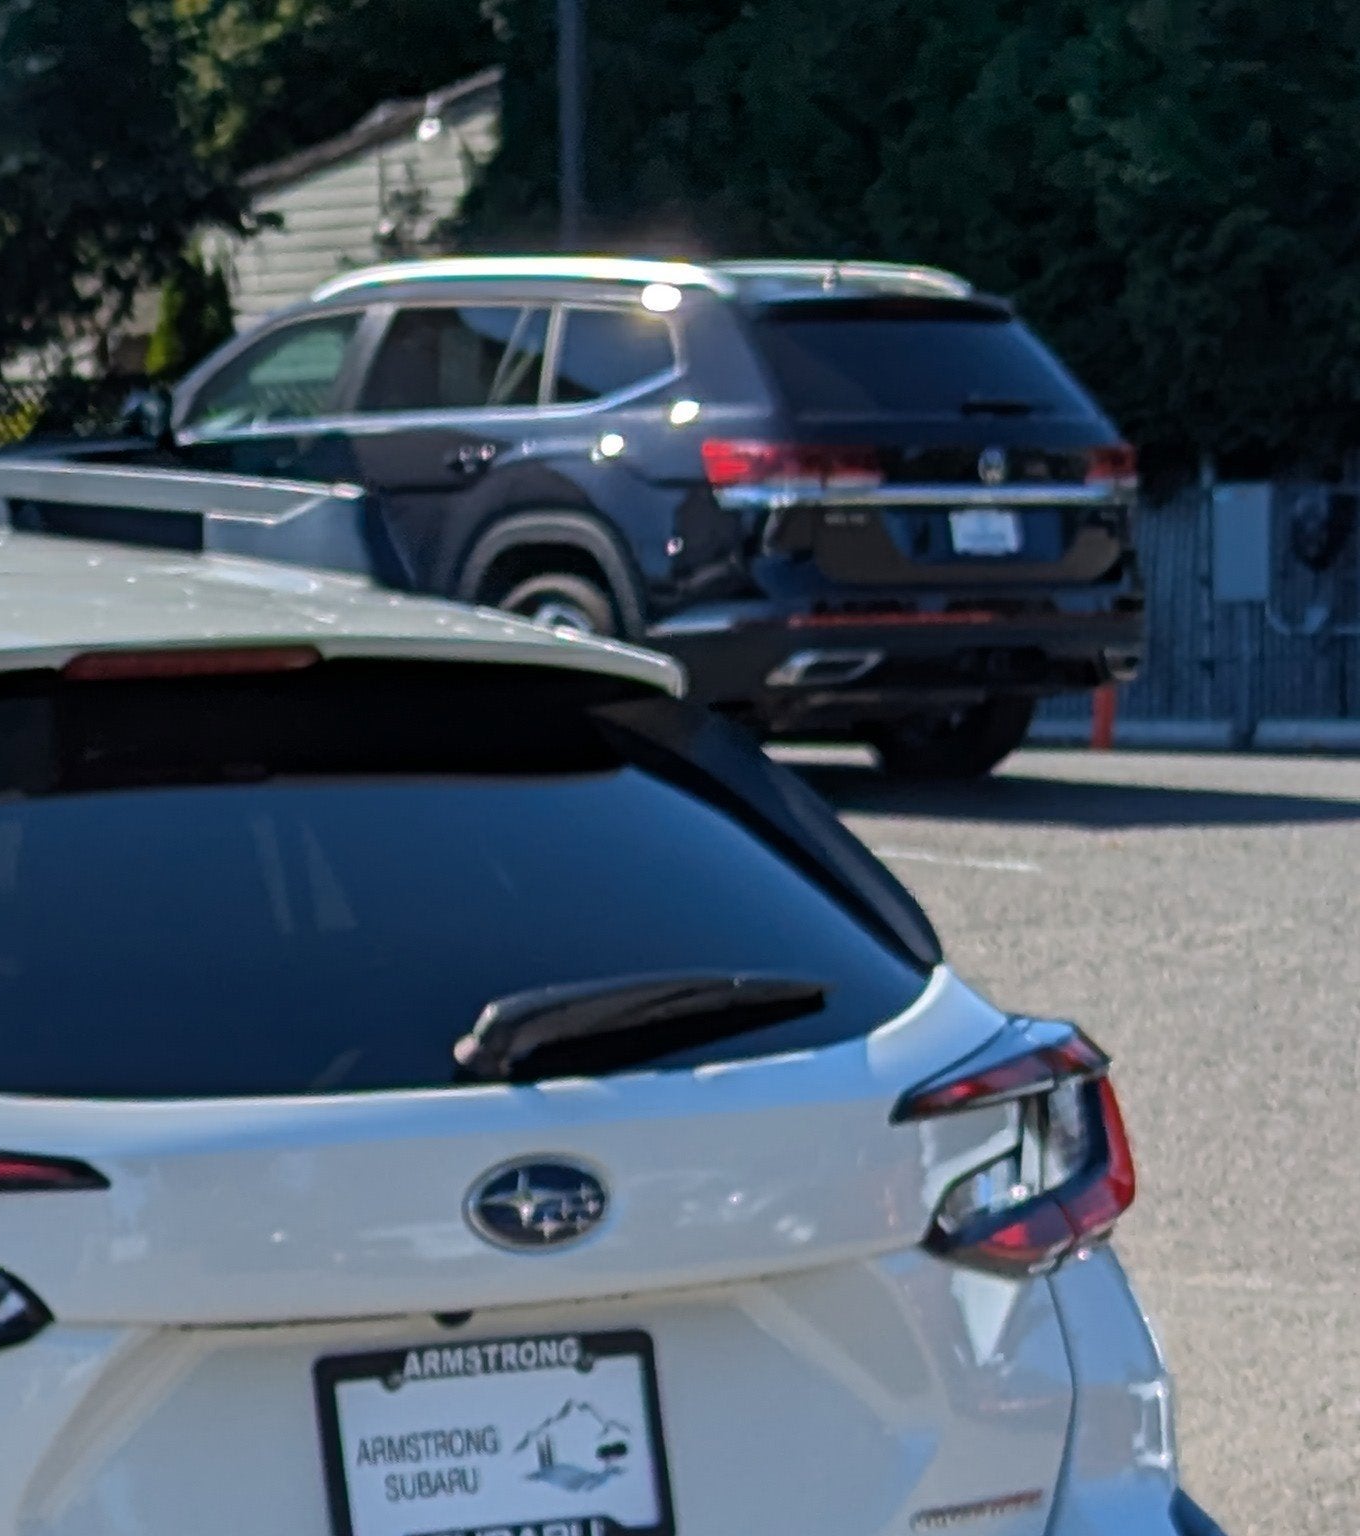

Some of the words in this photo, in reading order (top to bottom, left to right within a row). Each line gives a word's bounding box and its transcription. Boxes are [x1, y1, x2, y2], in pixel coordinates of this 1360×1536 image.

[403, 1337, 579, 1378] ARMSTRONG
[357, 1426, 500, 1467] ARMSTRONG
[385, 1467, 479, 1502] SUBARU
